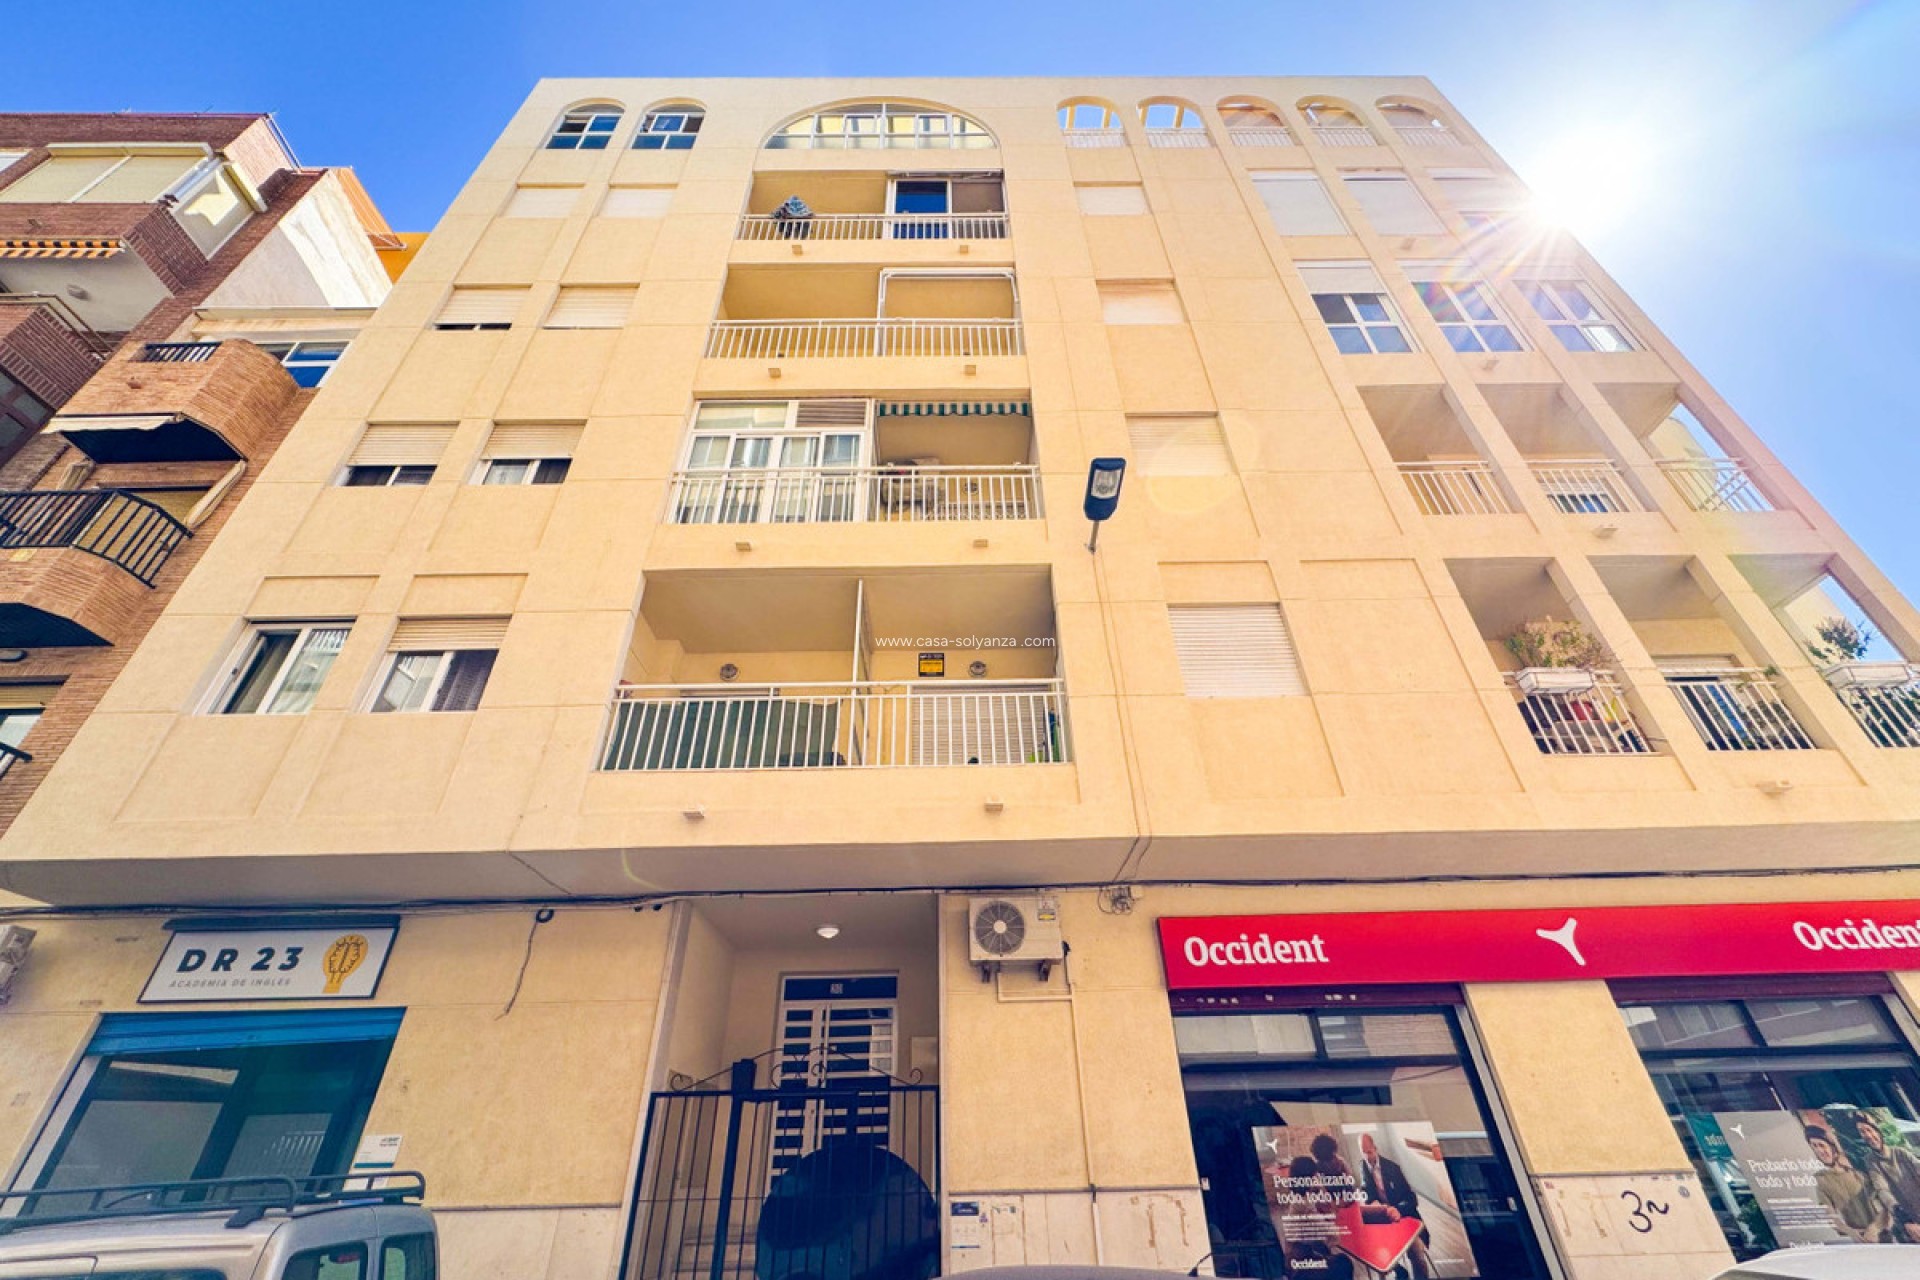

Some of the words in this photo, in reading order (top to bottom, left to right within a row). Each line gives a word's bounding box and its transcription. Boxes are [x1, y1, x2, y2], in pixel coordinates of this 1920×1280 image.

[1793, 918, 1920, 951] Occiden
[176, 948, 239, 973] DR
[250, 946, 304, 971] 23
[1184, 933, 1330, 967] Occident
[169, 979, 227, 988] ACADEMIA
[231, 978, 246, 987] DE
